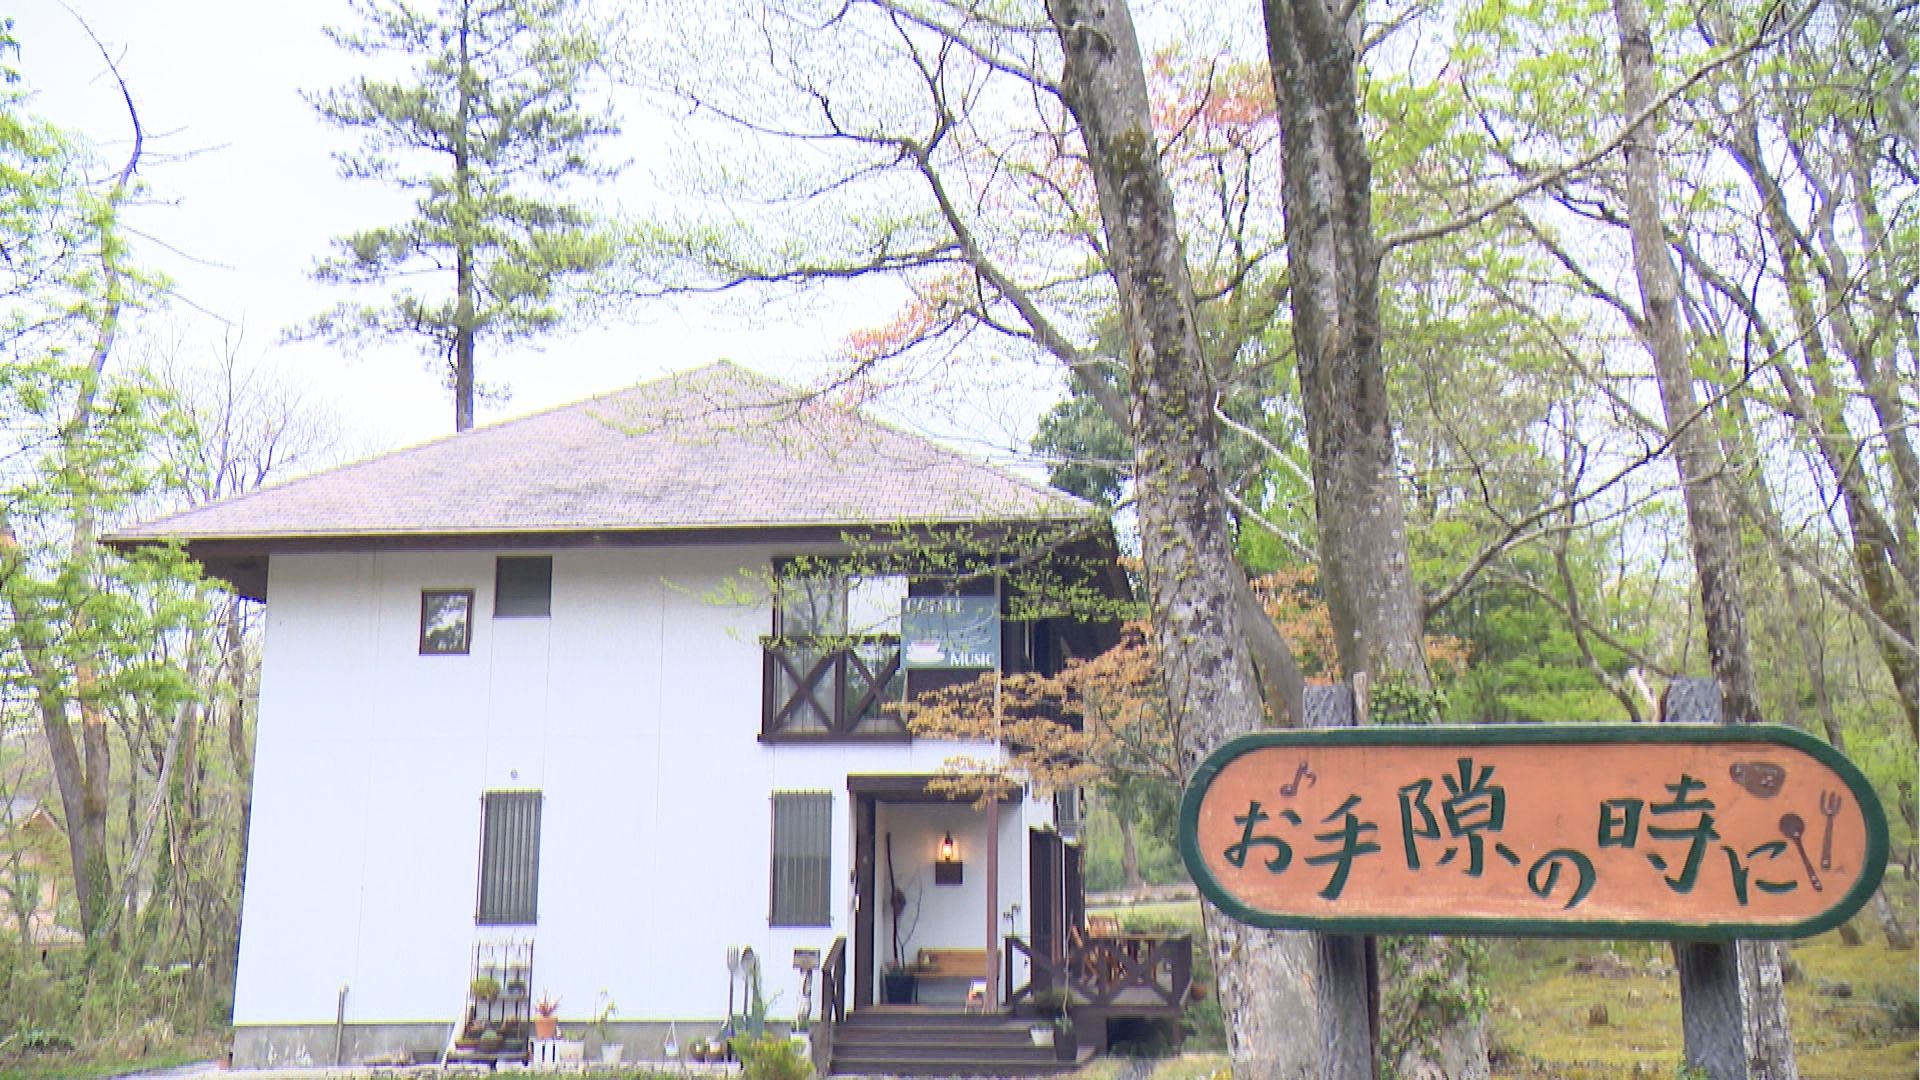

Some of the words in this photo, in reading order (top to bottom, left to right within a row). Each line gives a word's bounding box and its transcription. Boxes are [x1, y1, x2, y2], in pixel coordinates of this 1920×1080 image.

[1222, 757, 1798, 909] お手隙の時に
